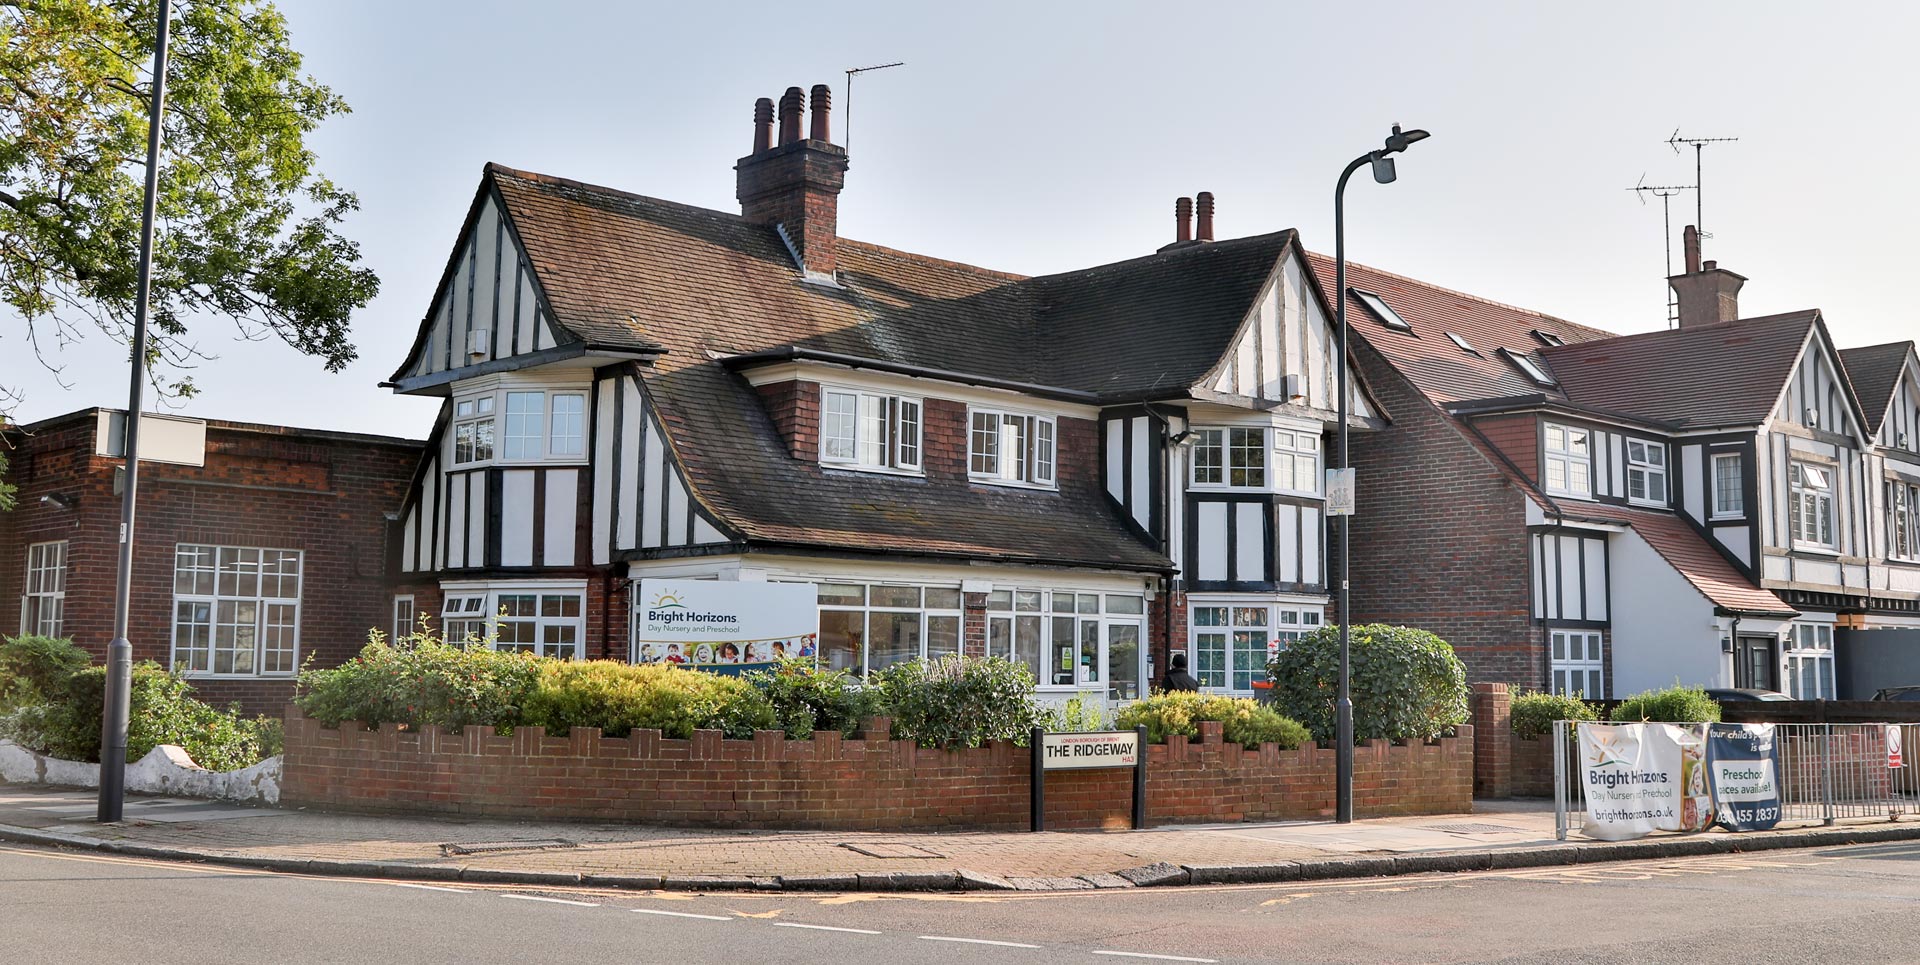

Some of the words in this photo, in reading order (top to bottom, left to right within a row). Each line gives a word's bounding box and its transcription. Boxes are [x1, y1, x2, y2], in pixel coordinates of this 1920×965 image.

[648, 610, 684, 624] Bright
[686, 611, 737, 623] Horizons
[647, 624, 662, 633] Day
[663, 624, 691, 634] Nursery
[692, 625, 705, 633] and
[706, 625, 740, 633] Preschool
[1046, 744, 1070, 758] THE
[1074, 743, 1134, 757] RIDGEWAY
[1589, 769, 1630, 789] Bright
[1591, 790, 1606, 802] Day
